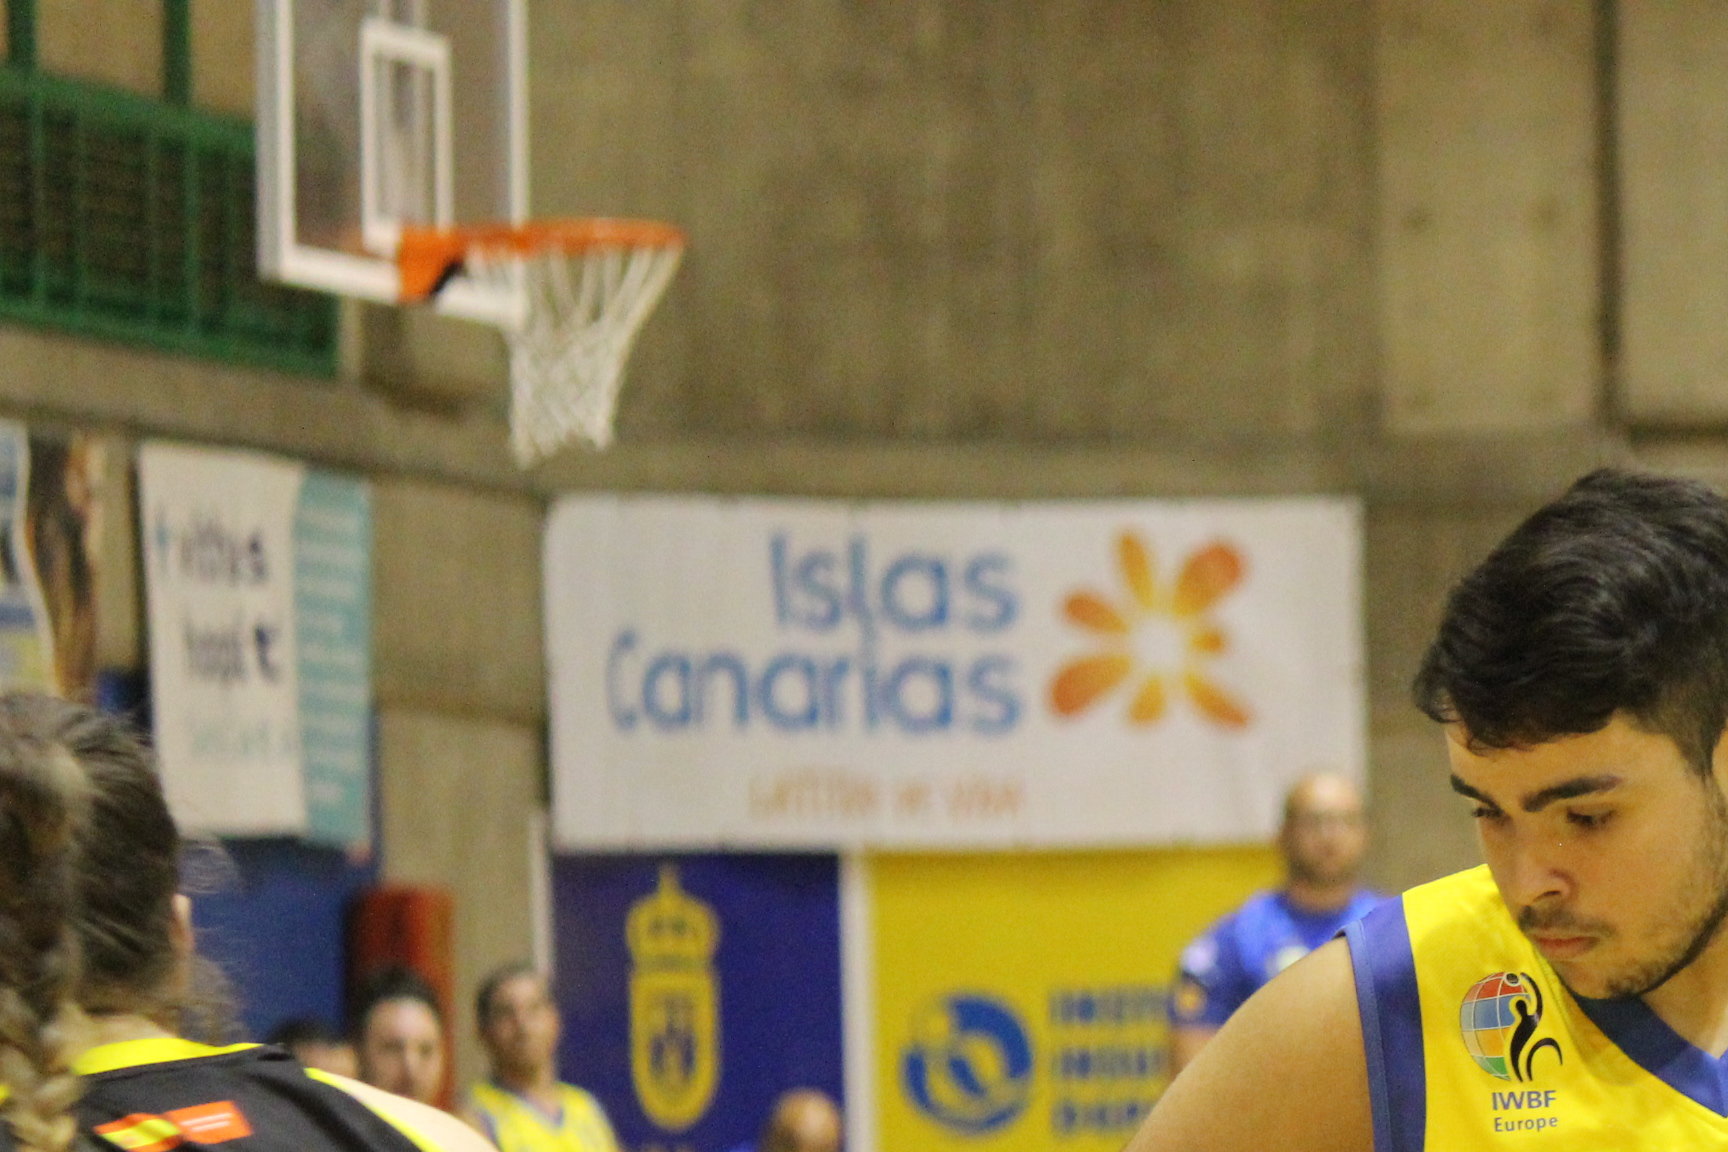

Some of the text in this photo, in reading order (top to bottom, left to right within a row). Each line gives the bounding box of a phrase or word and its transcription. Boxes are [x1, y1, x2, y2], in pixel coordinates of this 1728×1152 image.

[769, 527, 1021, 636] Islas
[608, 627, 1023, 735] Canarias
[1491, 1090, 1557, 1111] IWBF
[1494, 1116, 1559, 1132] Europe
